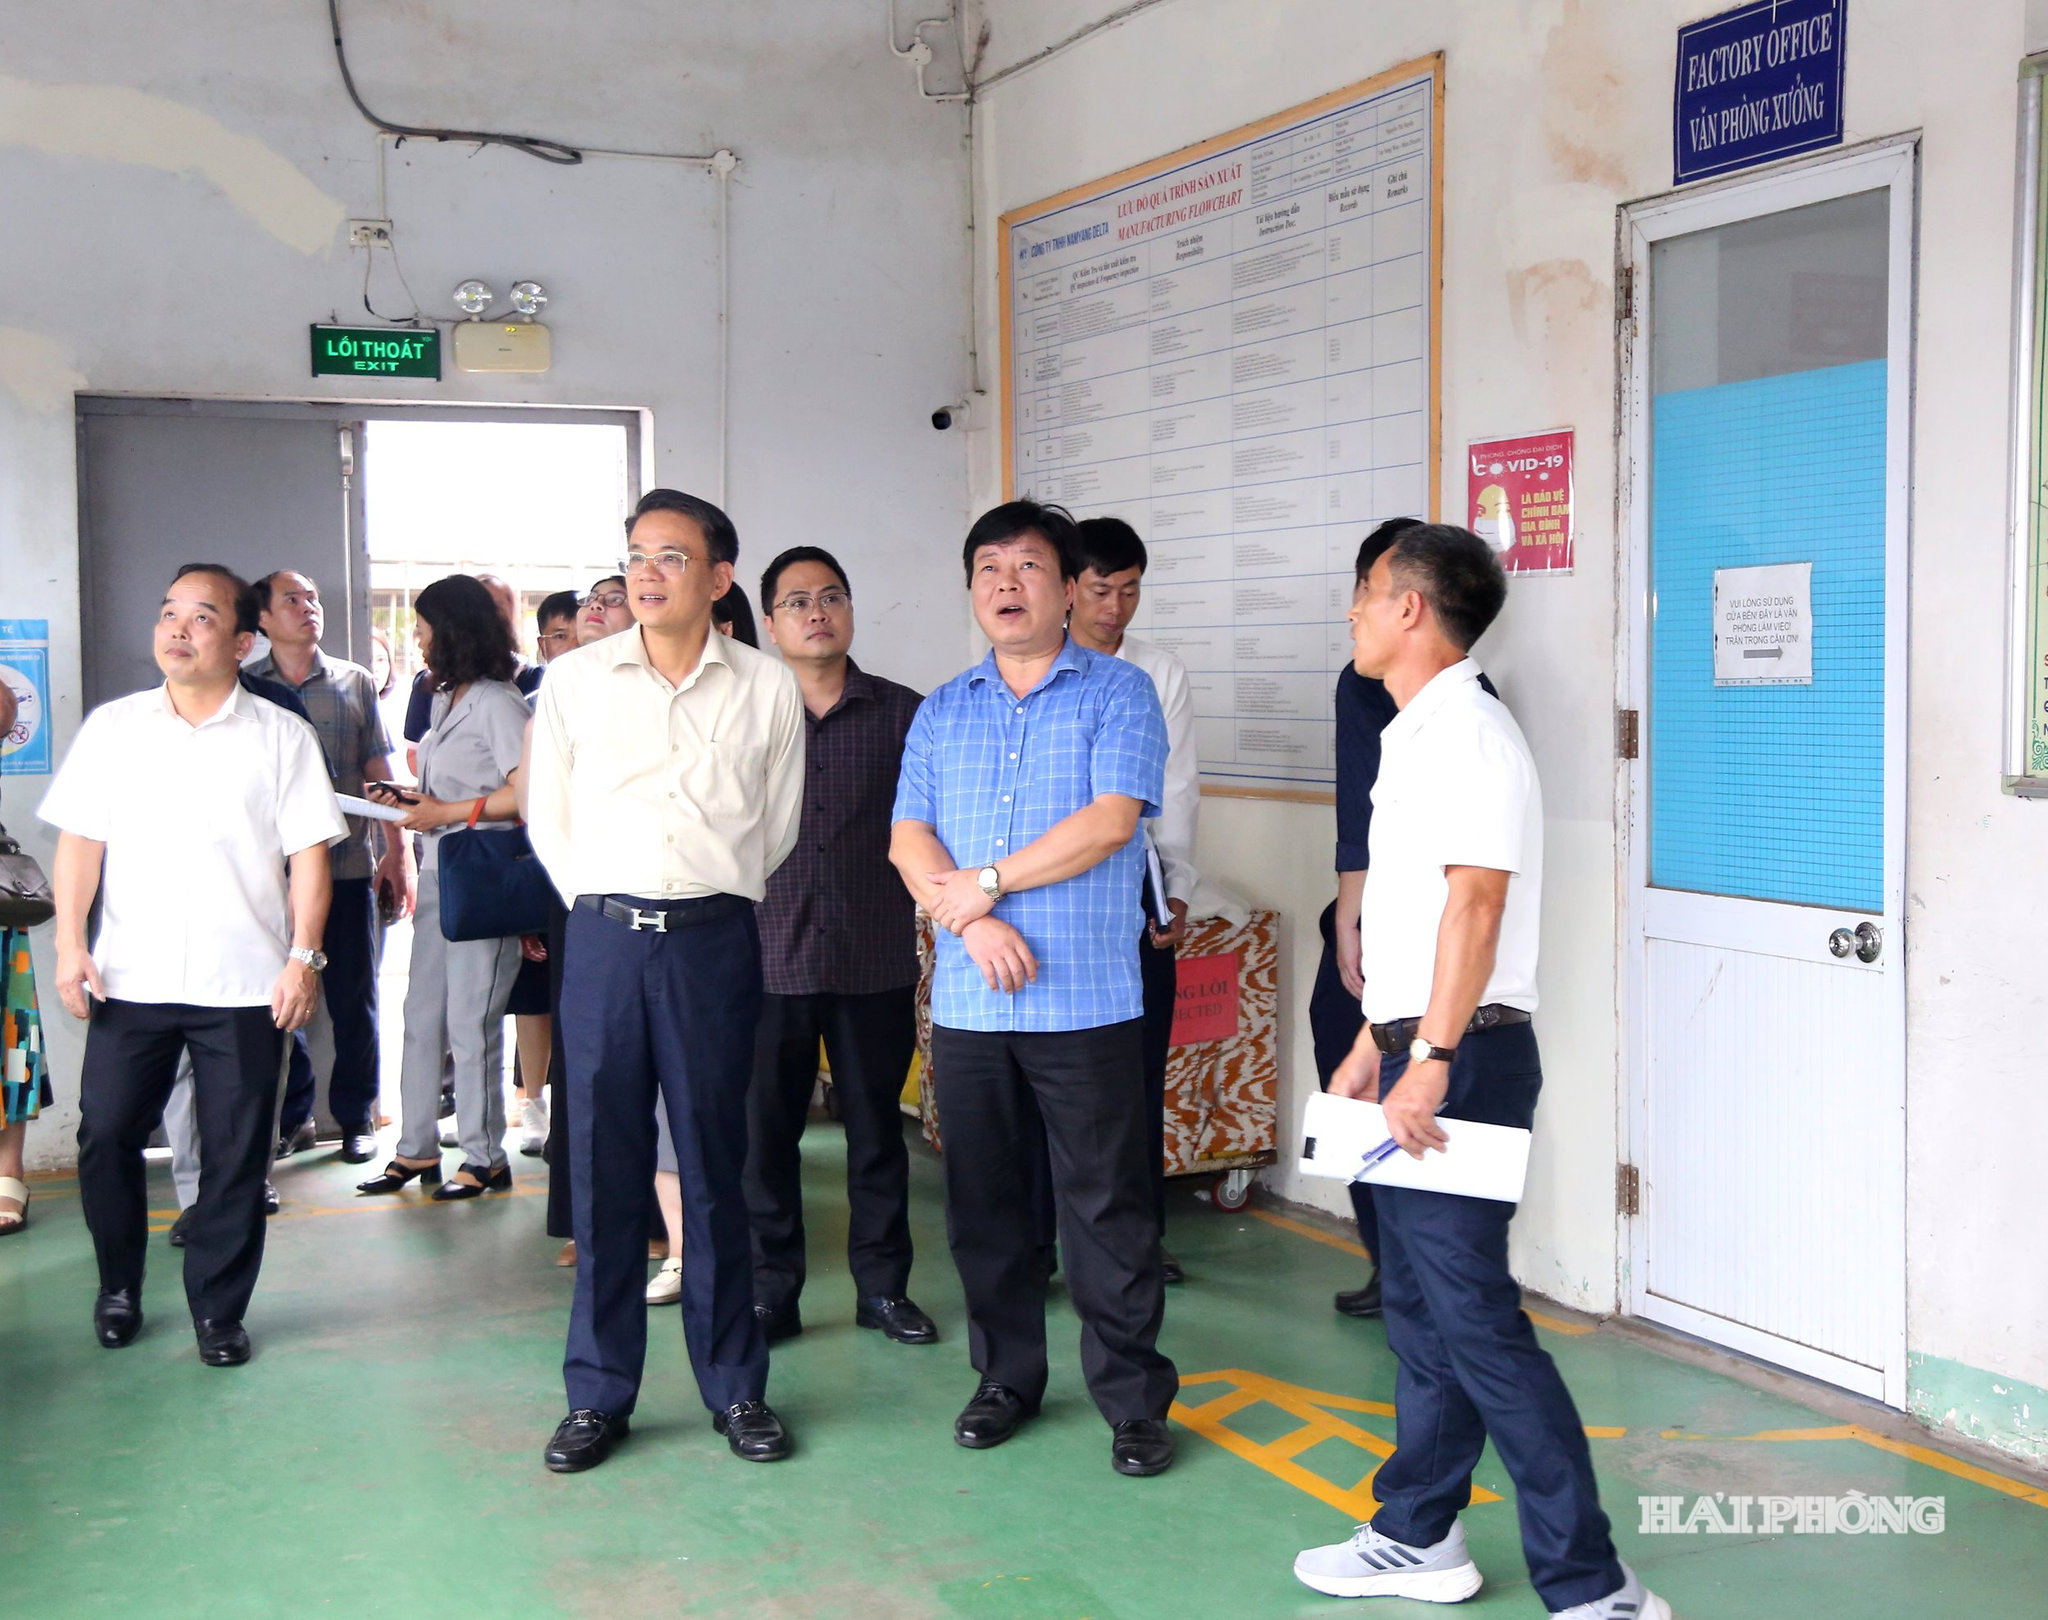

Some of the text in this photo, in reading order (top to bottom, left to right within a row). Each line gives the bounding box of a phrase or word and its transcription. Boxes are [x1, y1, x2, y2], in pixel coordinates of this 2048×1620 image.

[1687, 13, 1833, 92] FACTORY OFFICE
[1690, 73, 1824, 153] VĂN PHÒNG XƯỞNG
[1150, 185, 1168, 210] QUÁ
[1169, 180, 1197, 201] TRÌNH
[1198, 171, 1215, 191] SẢN
[1387, 184, 1409, 199] Remarks
[1117, 189, 1244, 241] MANUFACTURING FLOWCHART
[1067, 226, 1092, 247] NAMYANG
[1092, 221, 1109, 239] DELTA
[327, 335, 424, 360] LỐI THOÁT
[354, 361, 399, 372] EXIT
[1521, 521, 1536, 533] GIA
[1729, 599, 1741, 609] VUI
